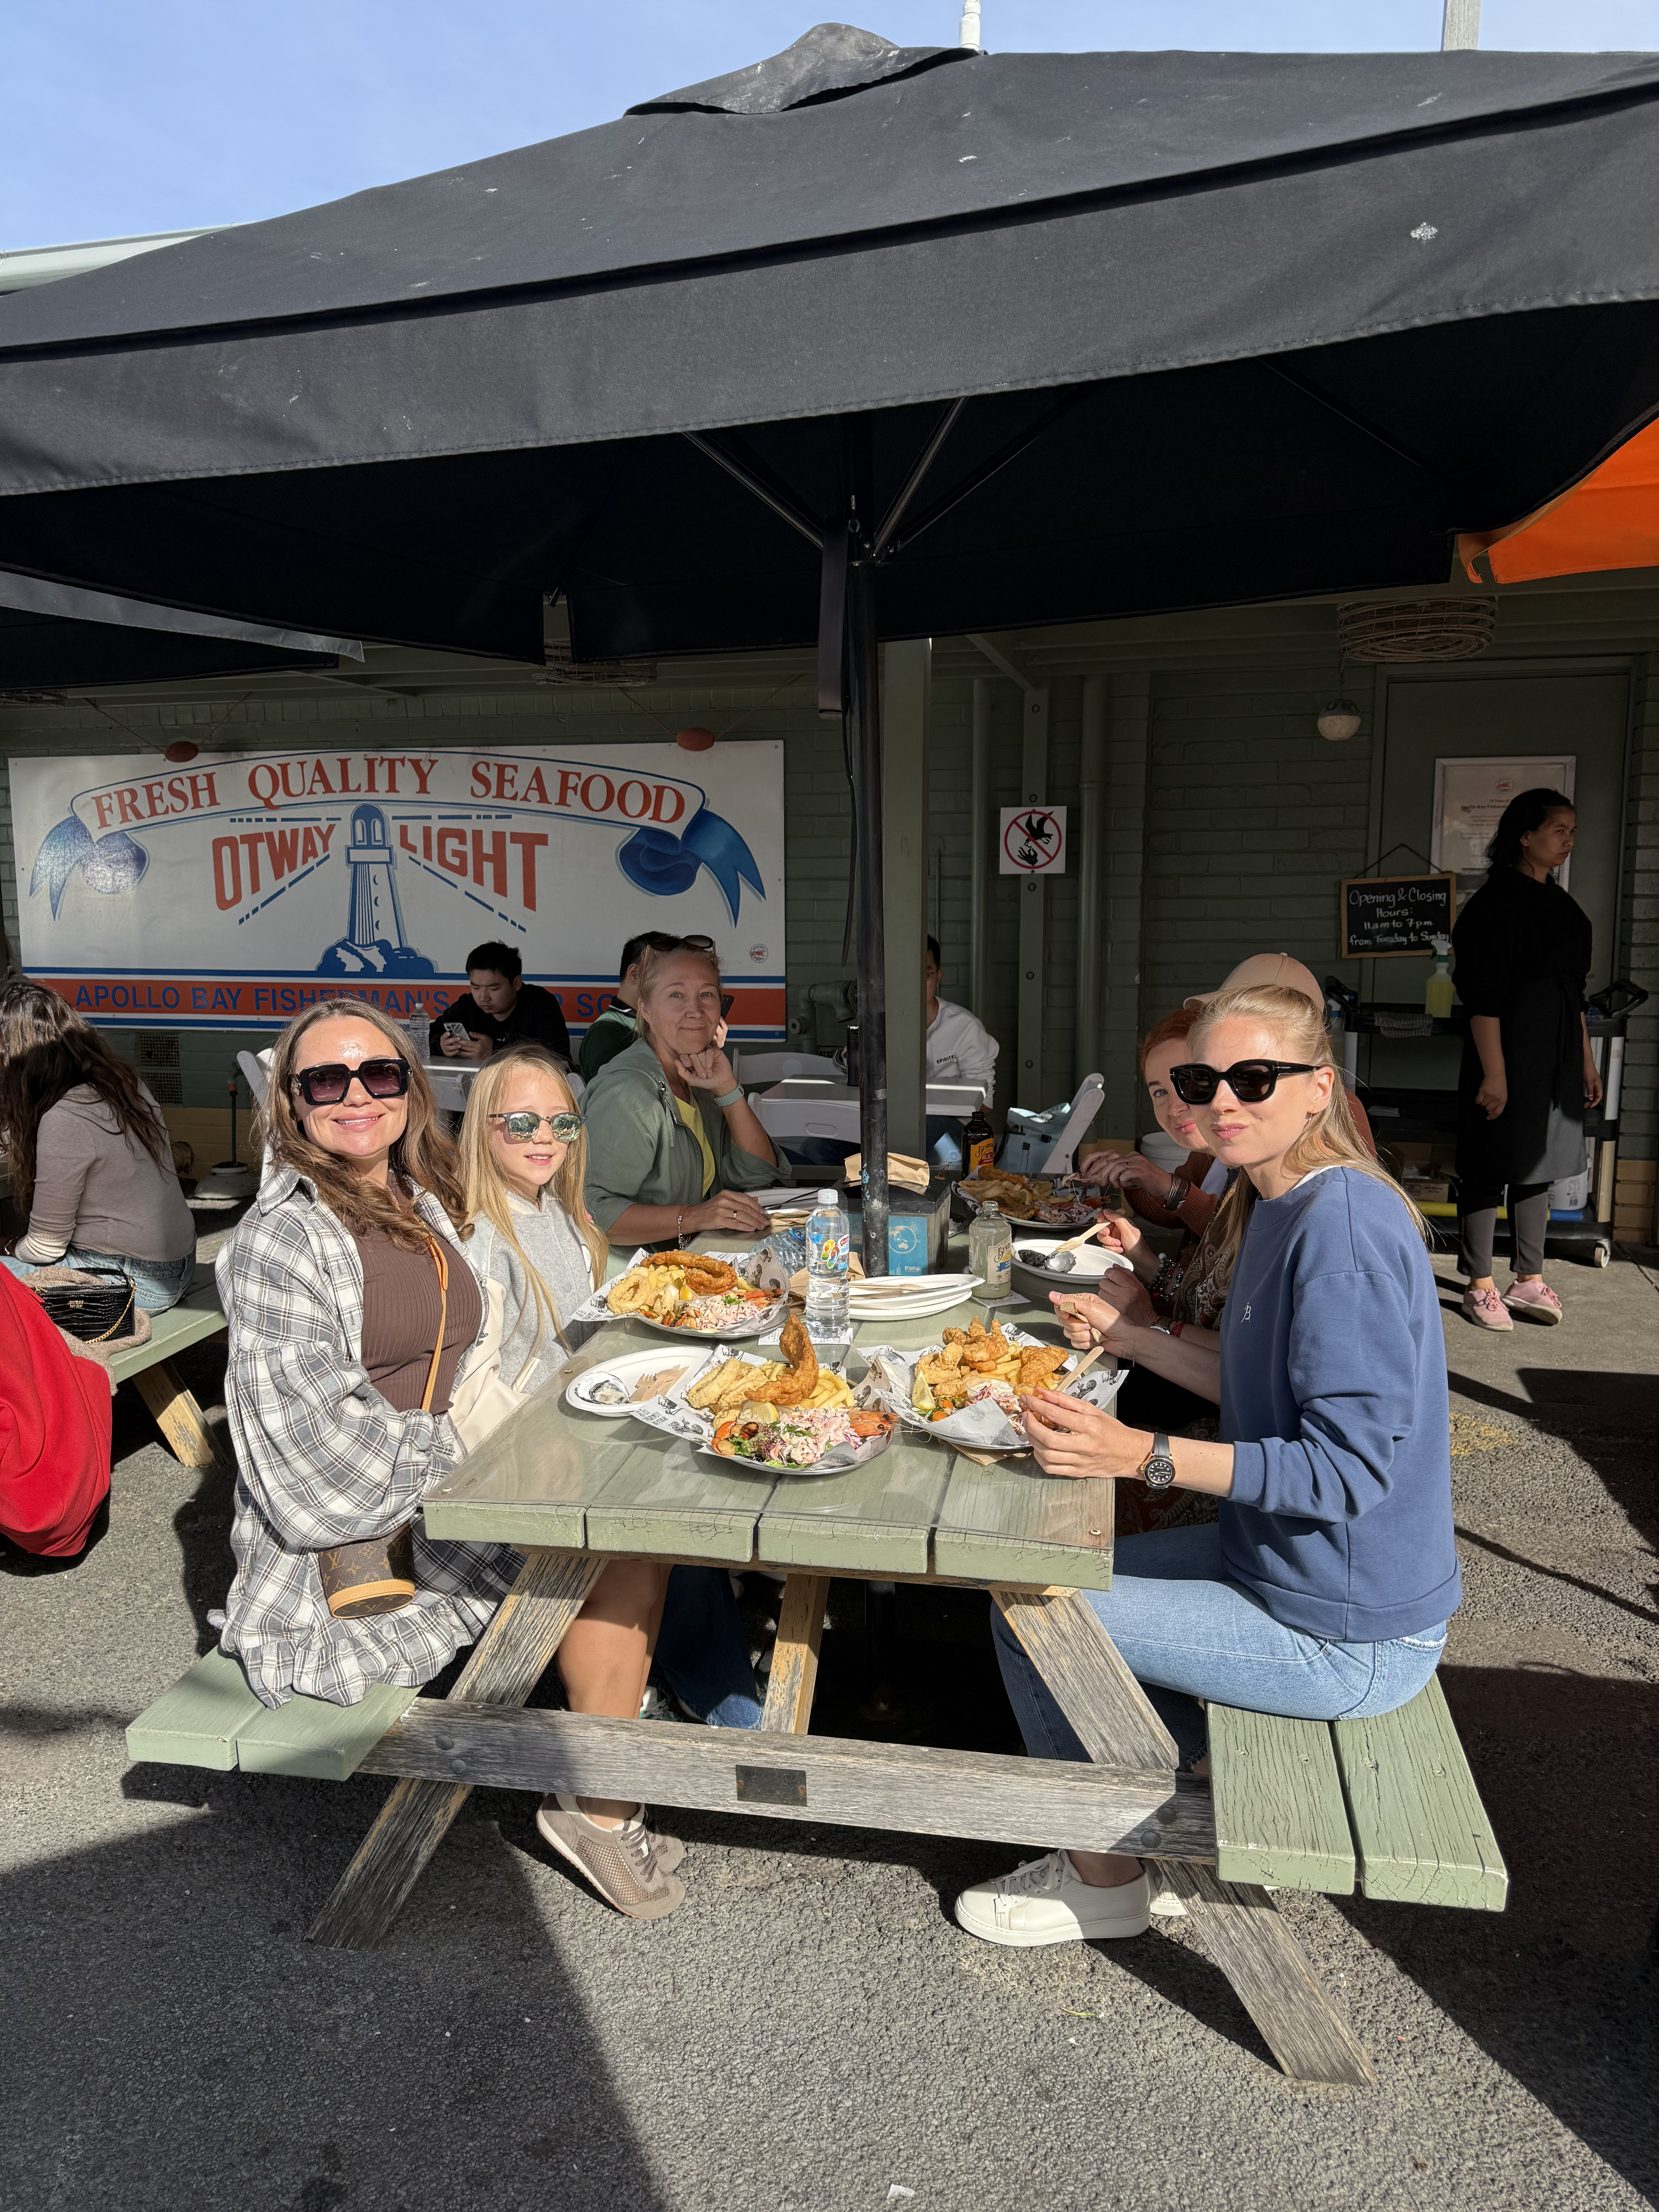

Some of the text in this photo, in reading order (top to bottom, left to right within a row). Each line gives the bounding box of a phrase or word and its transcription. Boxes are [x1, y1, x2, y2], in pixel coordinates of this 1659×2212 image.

[91, 757, 685, 829] FRESH QUALITY SEAFOOD
[212, 824, 548, 912] OTWAY LIGHT
[1349, 887, 1446, 908] Opening & Closing
[1376, 907, 1413, 918] Hours:
[1349, 934, 1372, 946] from
[1374, 933, 1408, 945] Tuesday
[1408, 932, 1418, 942] to
[76, 985, 180, 1010] APOLLO
[192, 988, 242, 1011] BAY
